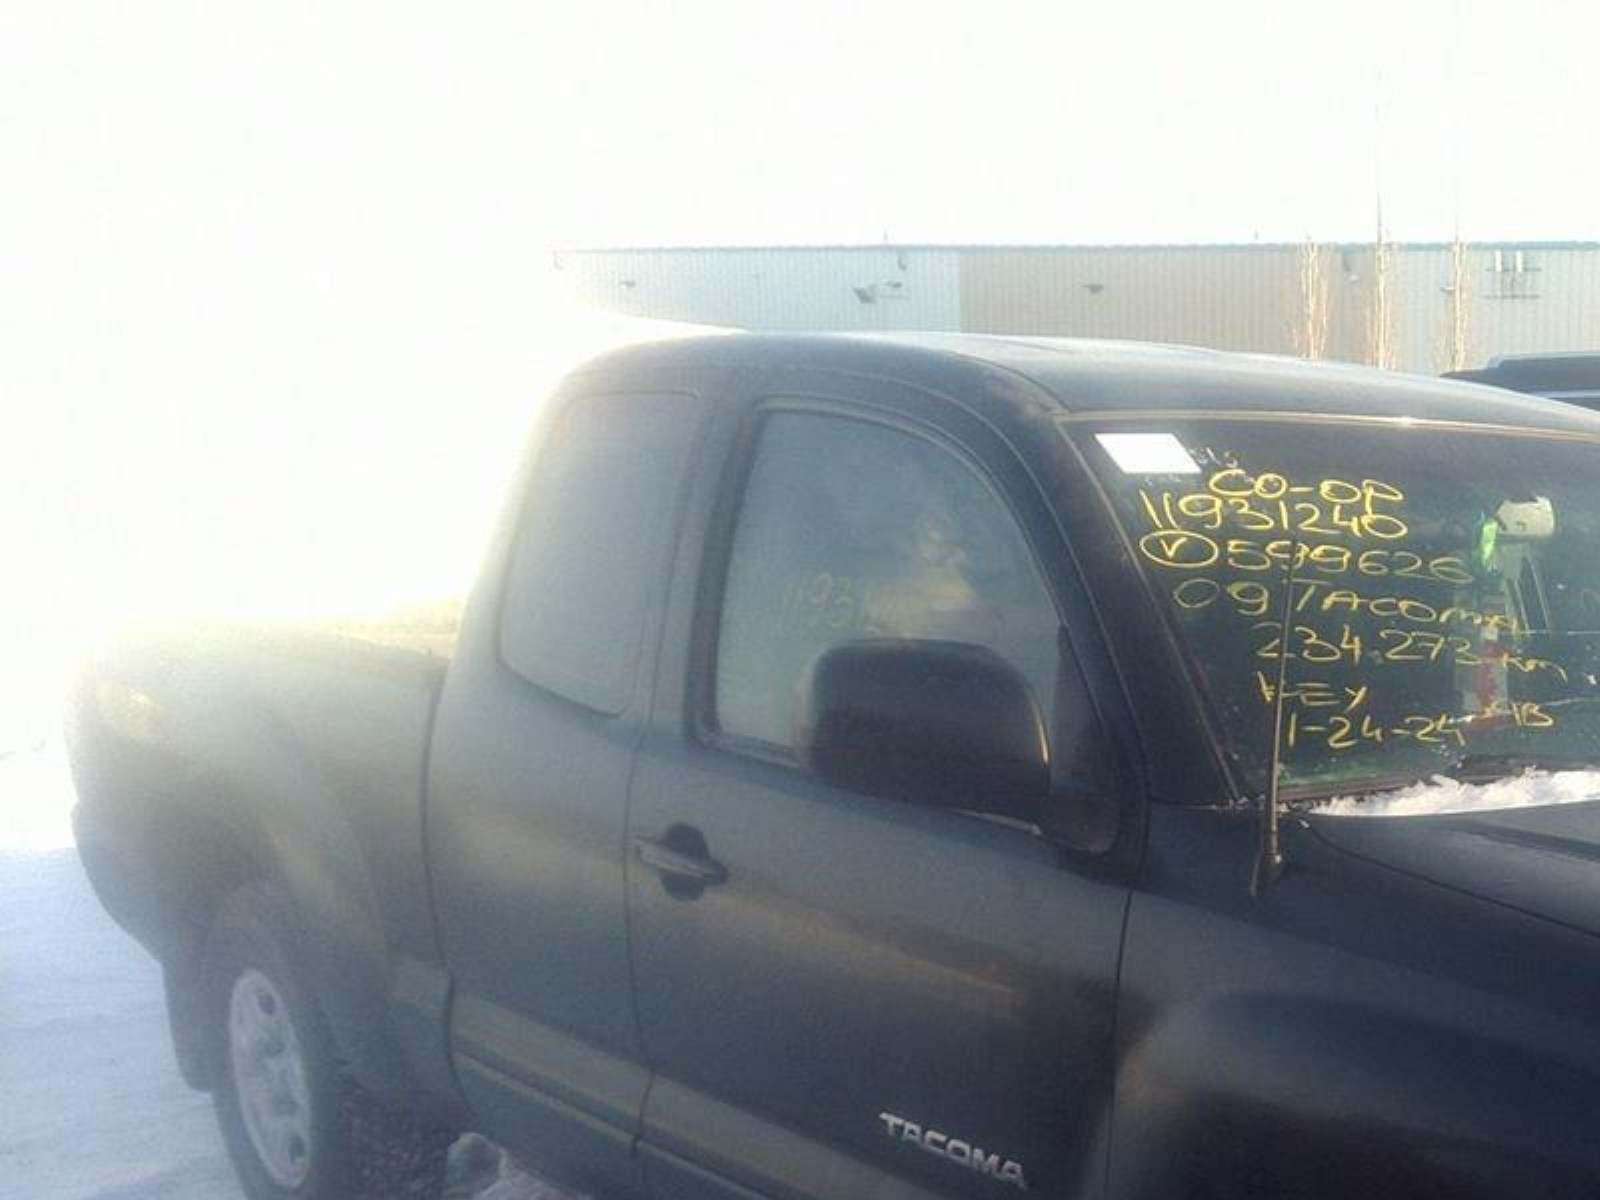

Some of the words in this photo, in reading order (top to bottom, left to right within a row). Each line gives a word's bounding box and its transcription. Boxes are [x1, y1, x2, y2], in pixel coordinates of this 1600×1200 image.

[1137, 488, 1408, 538] 11931240
[1208, 468, 1403, 517] CO-OP
[1173, 578, 1269, 615] 09
[879, 1112, 1028, 1190] TACOMA
